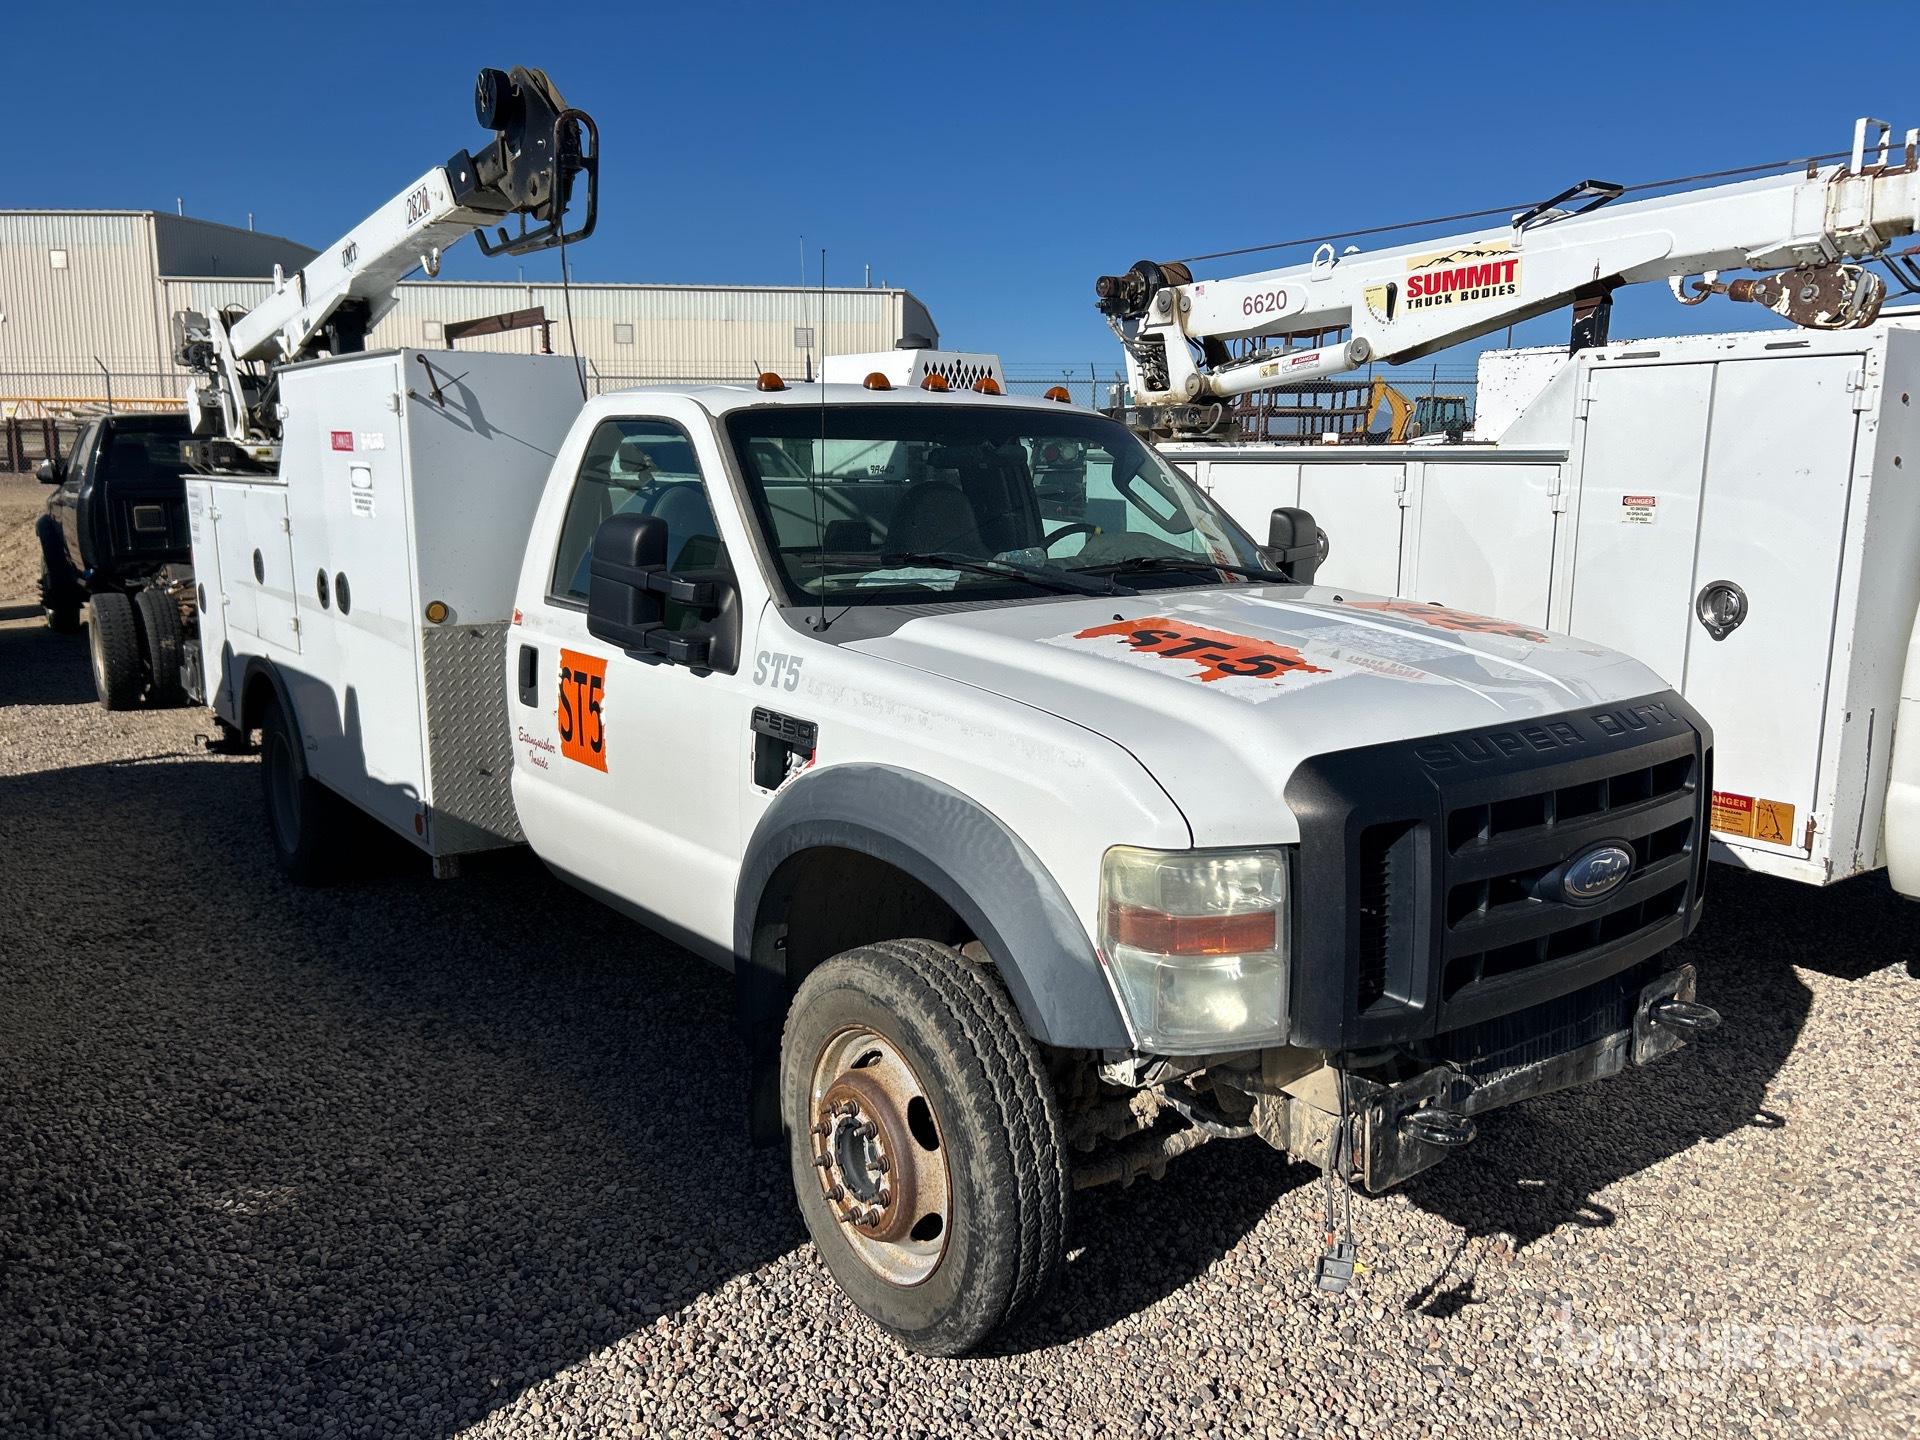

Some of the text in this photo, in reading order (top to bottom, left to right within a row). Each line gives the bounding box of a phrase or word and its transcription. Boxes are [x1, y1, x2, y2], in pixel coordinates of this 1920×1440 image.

[406, 186, 428, 225] 2820
[342, 242, 357, 268] IMT
[1406, 258, 1519, 299] SUMMIT
[1243, 290, 1287, 316] 6620
[1406, 283, 1516, 310] TRUCK BODIES
[1116, 629, 1300, 677] ST-5
[753, 650, 804, 692] ST5
[559, 666, 603, 754] ST5
[754, 710, 811, 739] F-550
[518, 726, 556, 754] Extinguisher
[1414, 701, 1678, 771] SUPER DUTY
[529, 749, 549, 770] Inside
[1712, 794, 1747, 808] ANGER
[1585, 857, 1621, 889] Ford
